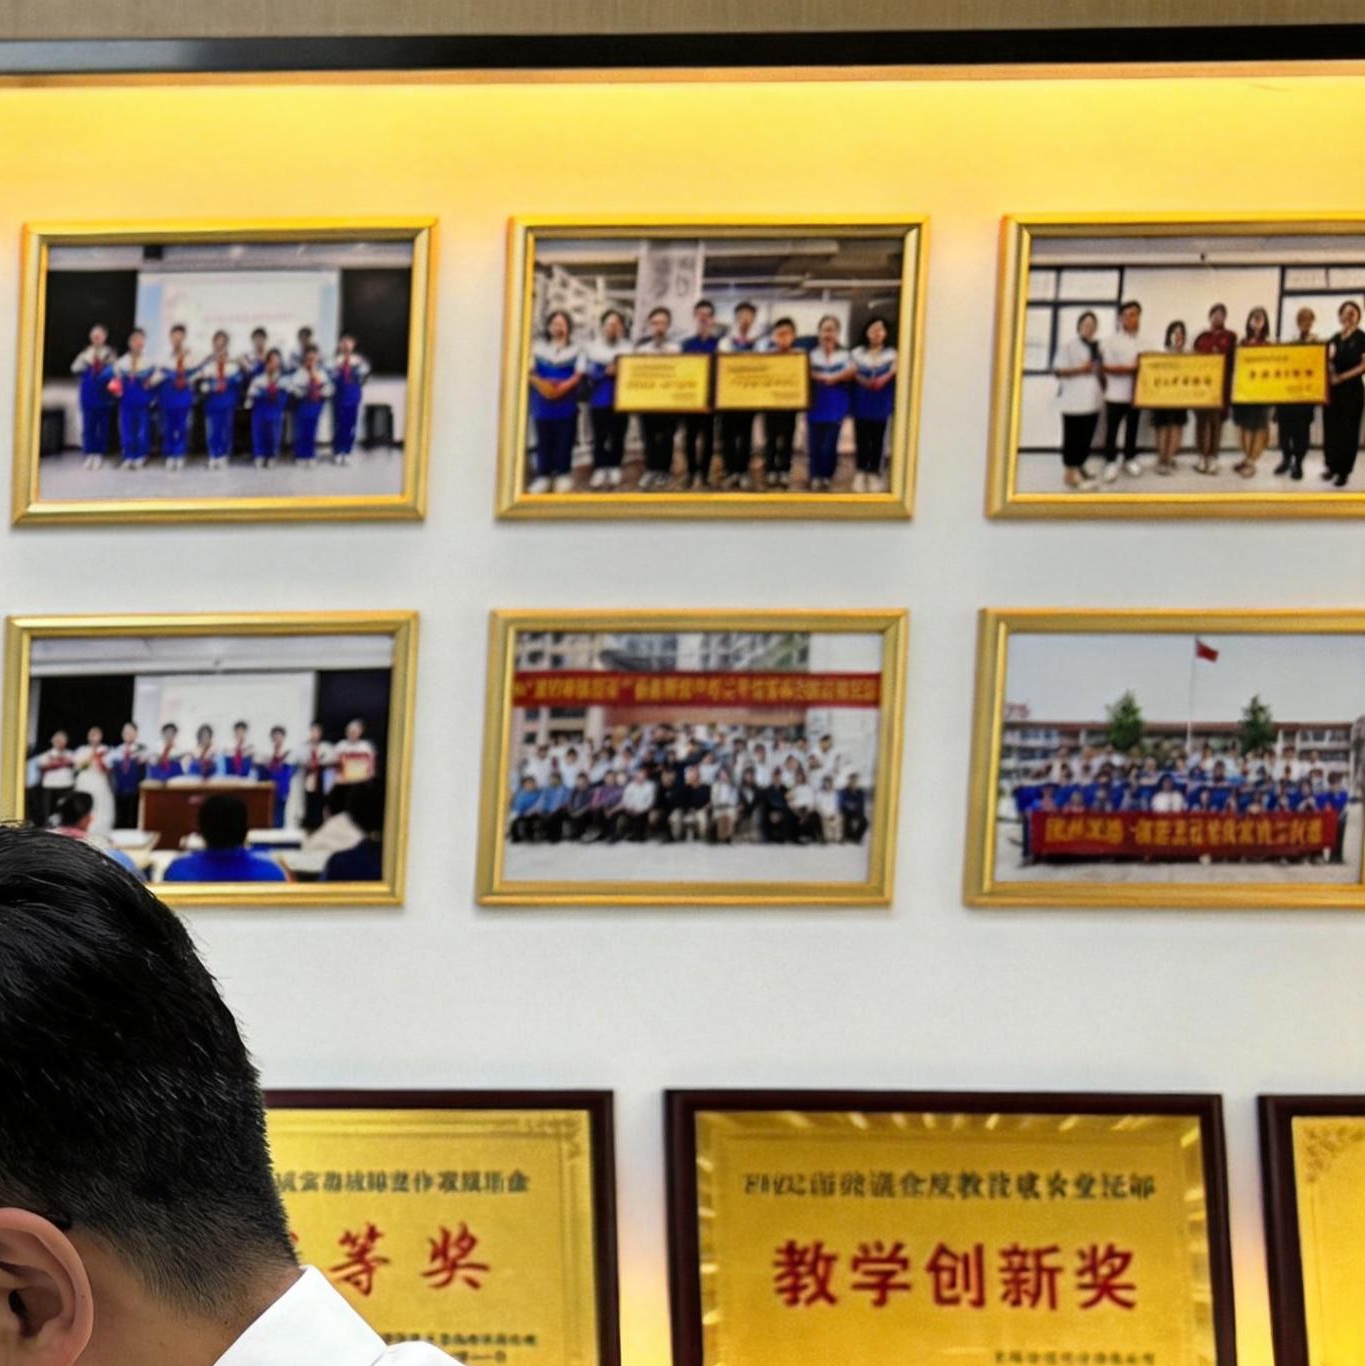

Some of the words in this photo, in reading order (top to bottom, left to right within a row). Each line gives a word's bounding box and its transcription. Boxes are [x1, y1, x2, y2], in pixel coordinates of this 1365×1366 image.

[289, 1220, 492, 1297] 等奖
[771, 1238, 1139, 1312] 教学创新奖
